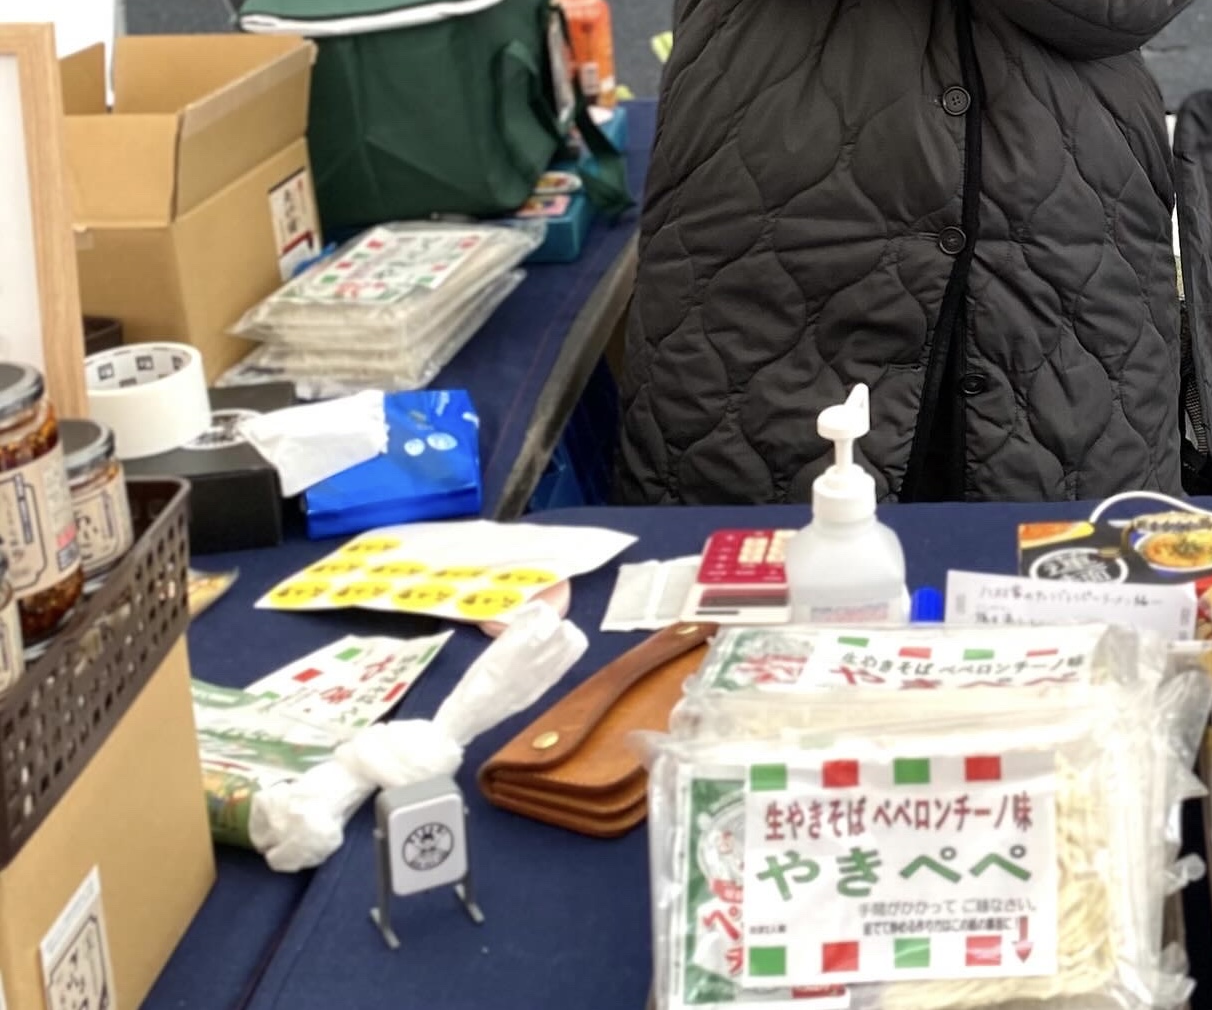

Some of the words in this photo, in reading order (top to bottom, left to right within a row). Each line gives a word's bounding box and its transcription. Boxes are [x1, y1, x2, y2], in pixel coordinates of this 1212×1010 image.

[763, 796, 867, 842] 生やきそば
[871, 790, 1034, 833] ペペロンチーノ味
